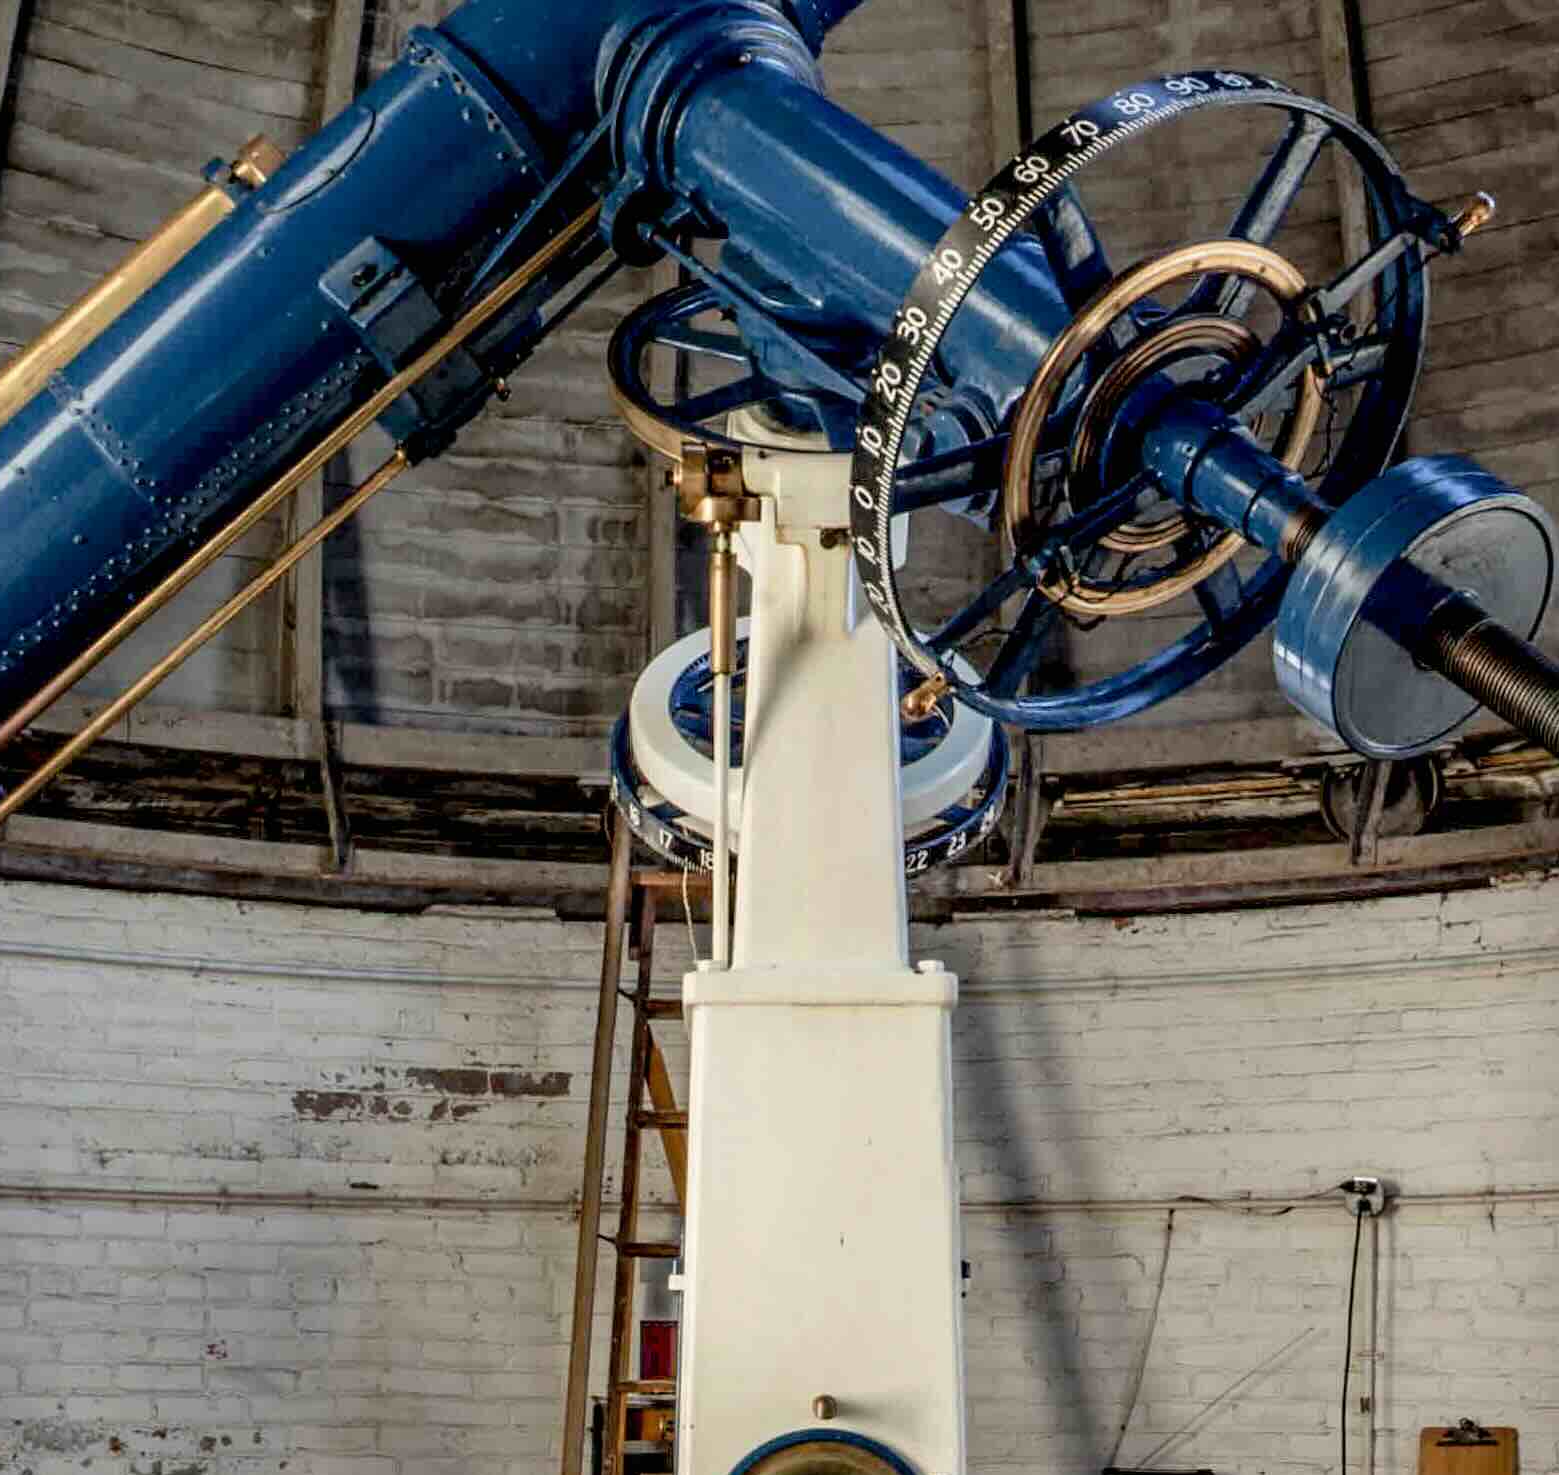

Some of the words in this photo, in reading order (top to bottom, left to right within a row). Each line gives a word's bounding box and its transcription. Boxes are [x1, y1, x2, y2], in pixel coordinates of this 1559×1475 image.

[1164, 76, 1210, 96] 90
[1112, 92, 1156, 115] 80
[1060, 119, 1099, 146] 70
[1012, 155, 1050, 184] 60
[969, 197, 1006, 232] 50
[931, 248, 963, 286] 40
[896, 306, 928, 345] 30
[875, 362, 903, 403] 20
[860, 426, 883, 457] 10
[853, 485, 874, 511] 0
[659, 828, 673, 849] 17
[905, 850, 929, 873] 22
